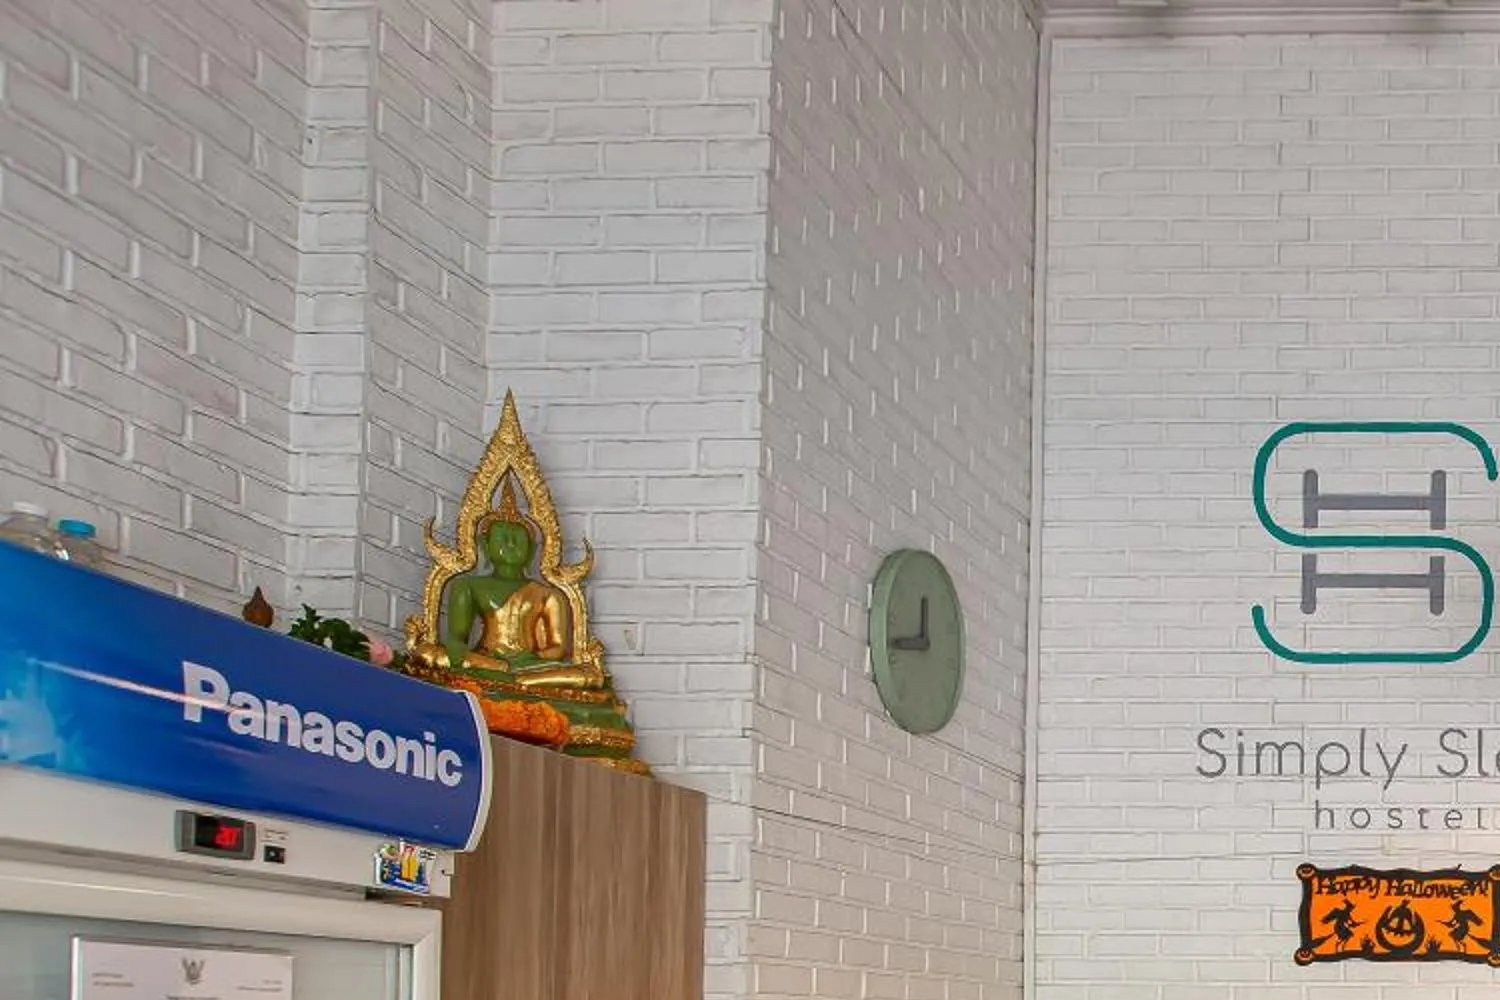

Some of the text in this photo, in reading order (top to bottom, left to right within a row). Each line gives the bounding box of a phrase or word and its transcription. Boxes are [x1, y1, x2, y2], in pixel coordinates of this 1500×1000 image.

[182, 660, 463, 787] Panasonic
[1196, 728, 1408, 790] Simply
[1315, 800, 1488, 829] hostel
[1314, 876, 1380, 898] Happy
